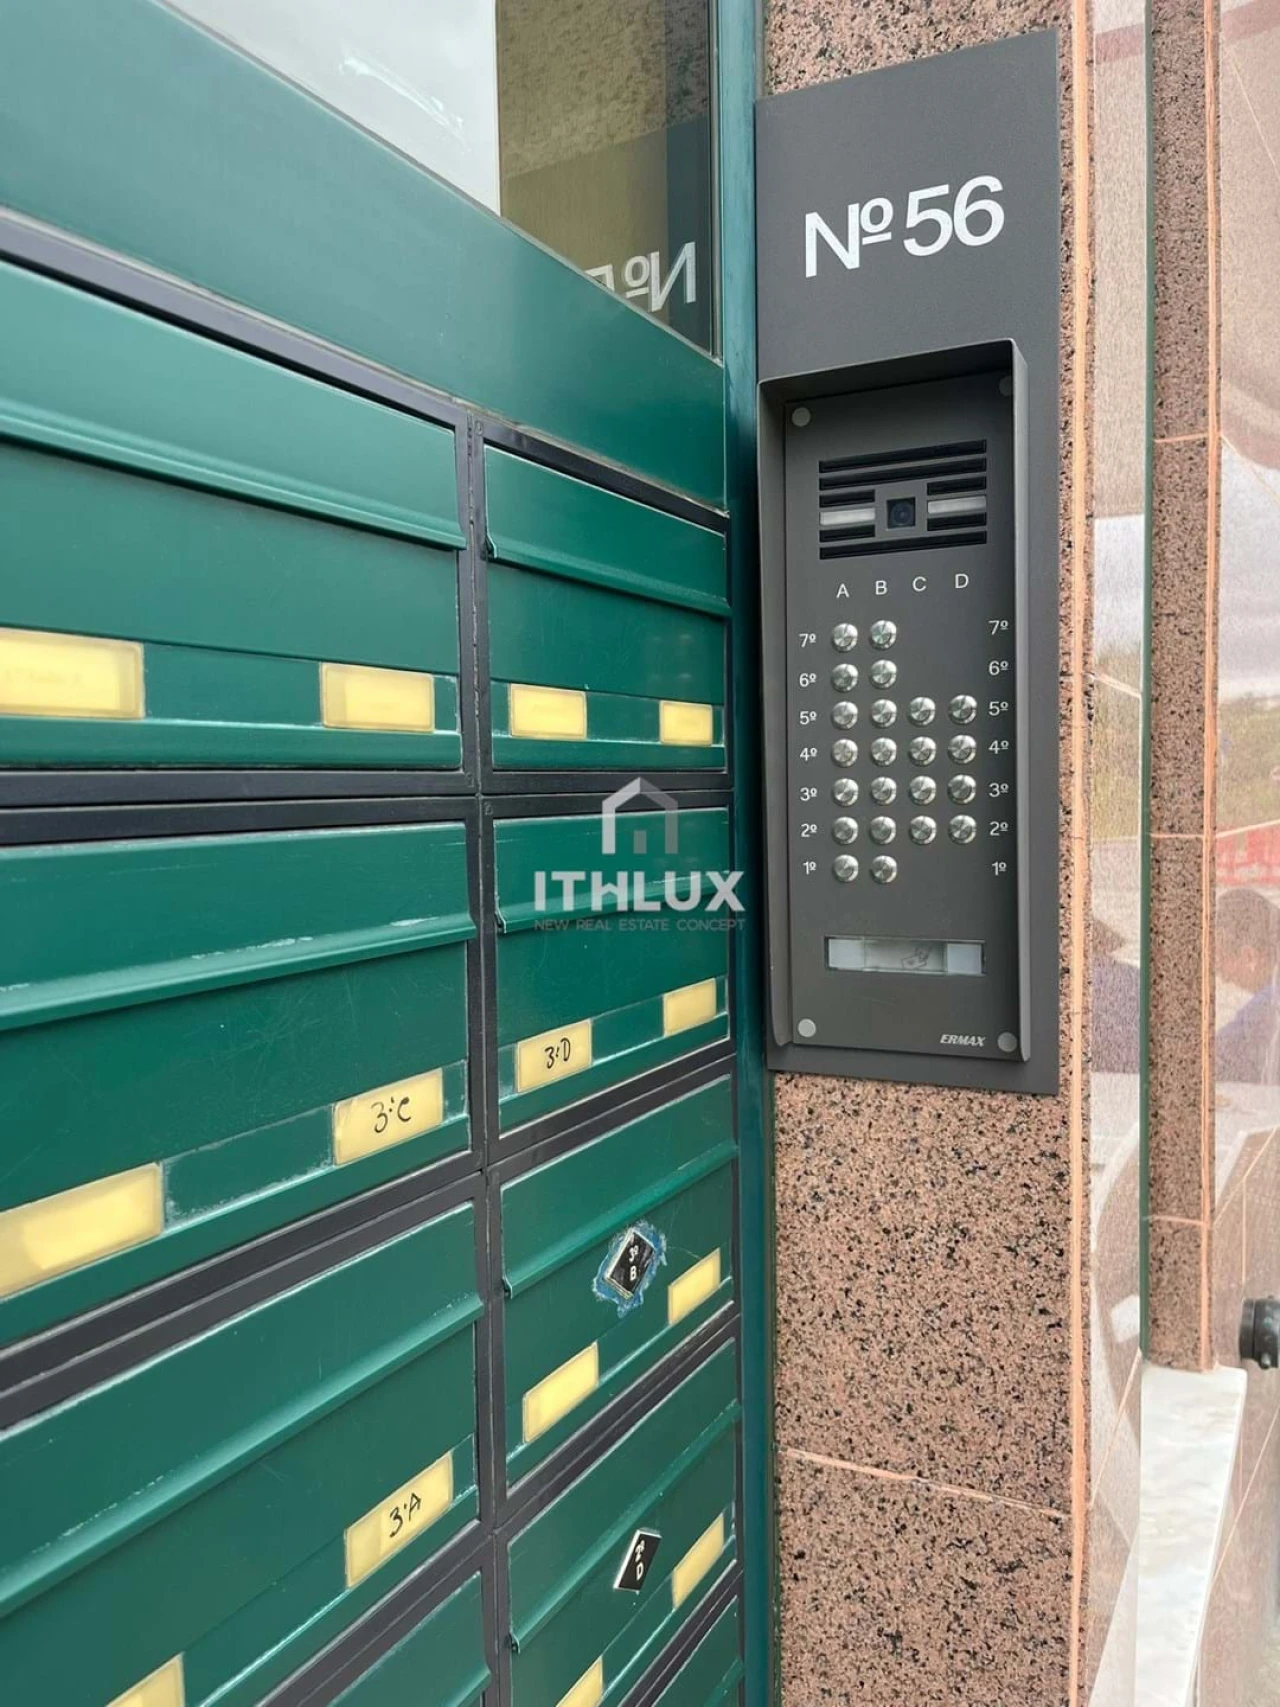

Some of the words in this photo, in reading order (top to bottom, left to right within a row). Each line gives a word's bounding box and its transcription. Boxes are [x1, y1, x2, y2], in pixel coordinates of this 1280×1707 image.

[903, 175, 1004, 256] 56
[836, 584, 850, 599] A
[875, 580, 888, 595] B
[912, 576, 927, 592] C
[955, 573, 969, 589] D
[988, 620, 1009, 636] 7º
[799, 633, 816, 648] 7º
[988, 660, 1009, 676] 6º
[799, 673, 816, 687] 6º
[988, 701, 1009, 716] 5º
[799, 710, 817, 725] 5º
[800, 747, 817, 761] 4º
[989, 740, 1009, 754] 4º
[800, 787, 817, 801] 3º
[989, 783, 1009, 798] 3º
[801, 824, 817, 838] 2º
[989, 821, 1009, 836] 2º
[803, 861, 816, 875] 1º
[992, 861, 1007, 876] 1º
[940, 1034, 986, 1047] ERMAX
[629, 1265, 637, 1281] B
